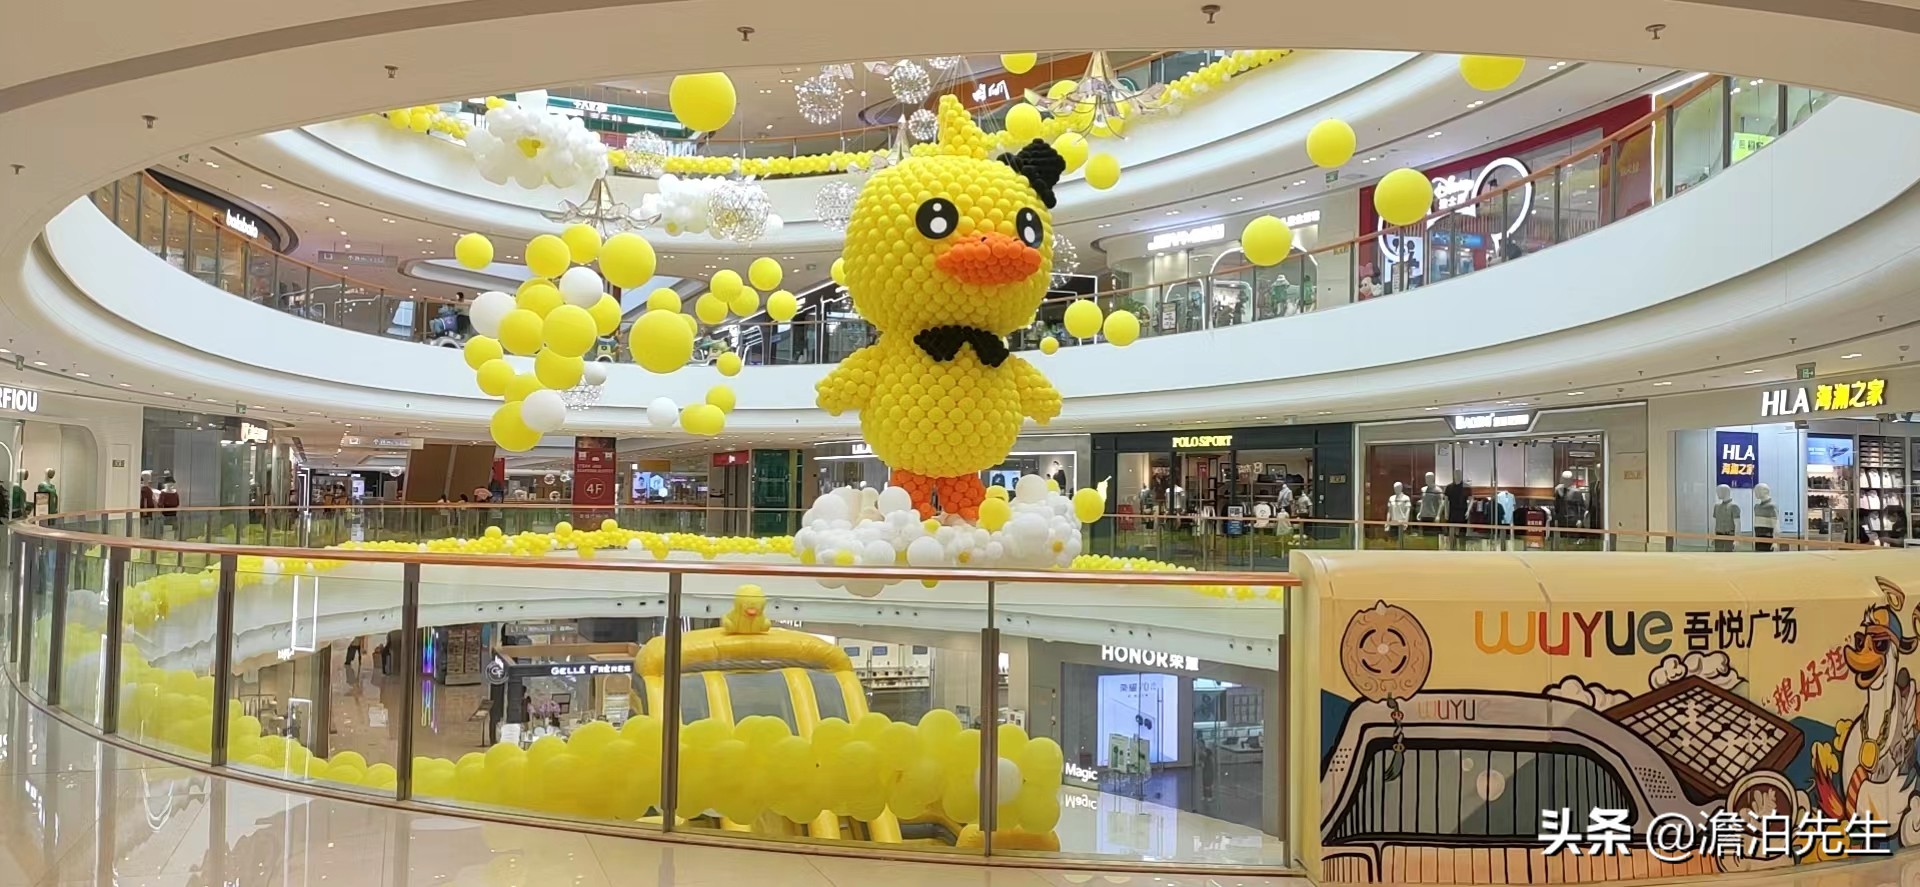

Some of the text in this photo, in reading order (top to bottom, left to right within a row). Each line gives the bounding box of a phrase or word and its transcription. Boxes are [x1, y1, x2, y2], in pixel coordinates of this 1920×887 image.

[0, 387, 38, 412] FIOU
[1761, 379, 1885, 416] HLA 海澜之家
[1722, 443, 1756, 461] HLA
[586, 483, 603, 495] 4F
[1683, 606, 1797, 651] 吾悦广场
[1065, 762, 1098, 782] Magic
